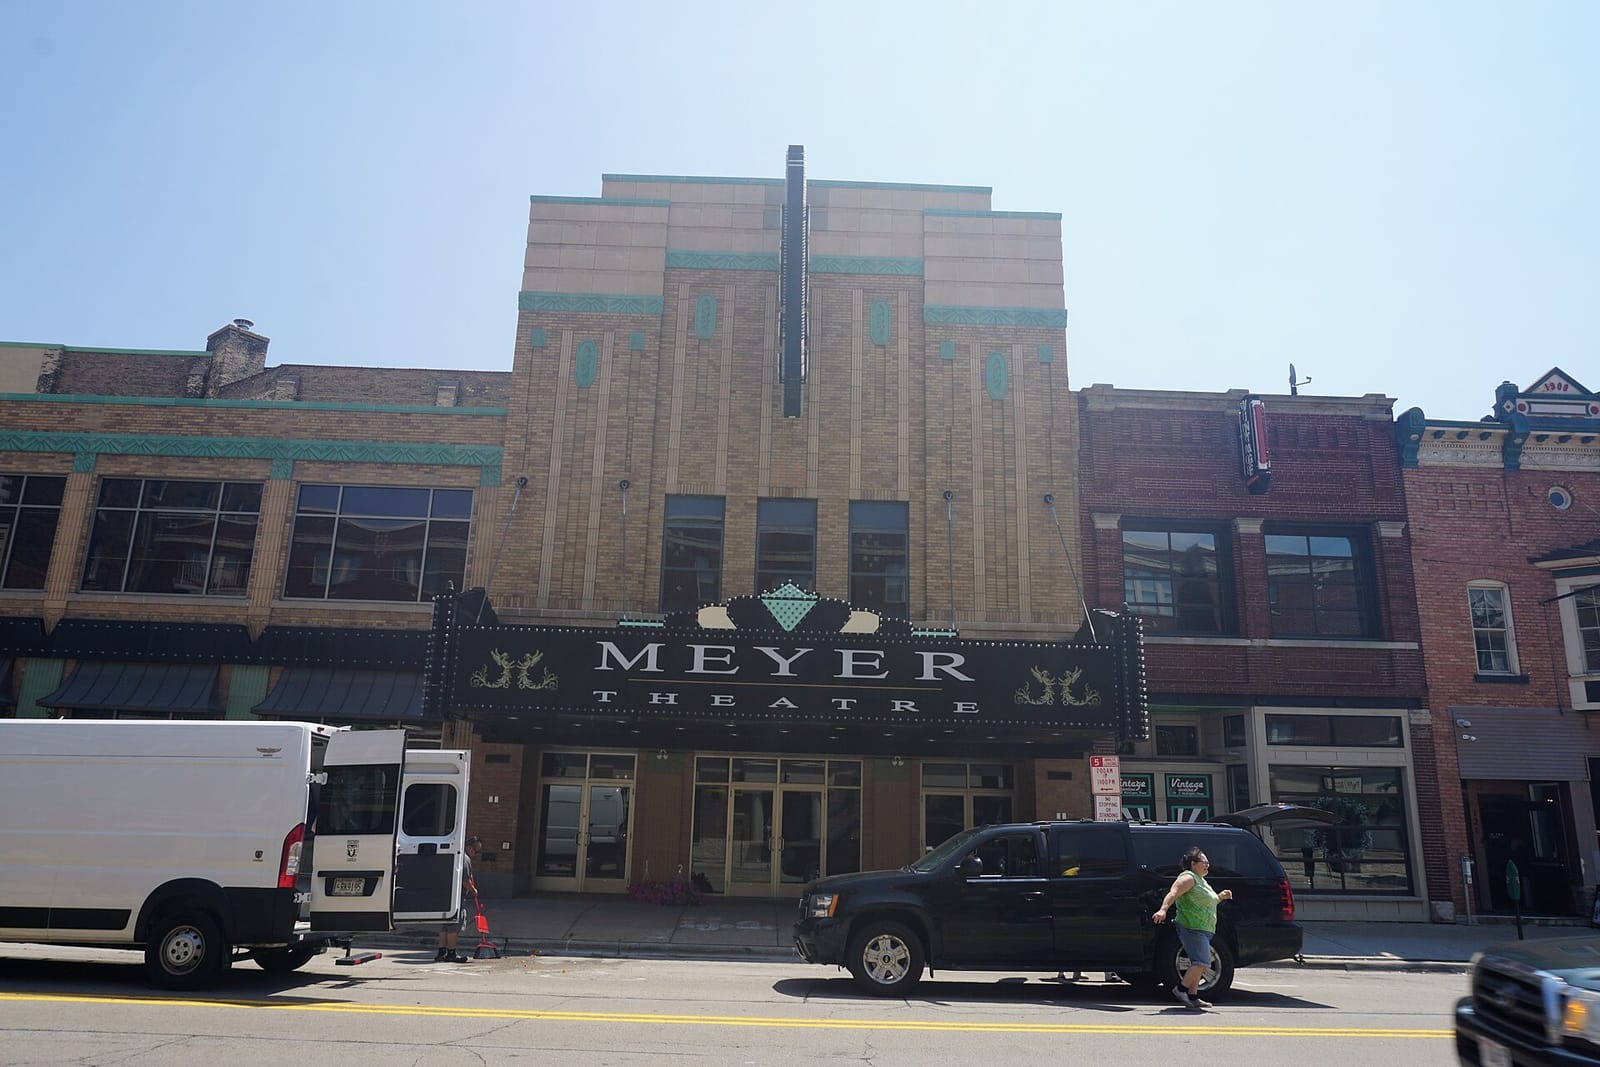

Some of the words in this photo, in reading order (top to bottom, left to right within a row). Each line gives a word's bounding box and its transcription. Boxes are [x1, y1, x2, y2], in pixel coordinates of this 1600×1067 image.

[1544, 382, 1569, 392] 1900
[593, 640, 976, 682] MEYER
[592, 690, 980, 714] THEATRE
[1094, 758, 1100, 767] 5
[1120, 778, 1147, 791] intage
[1171, 778, 1205, 792] Vintage
